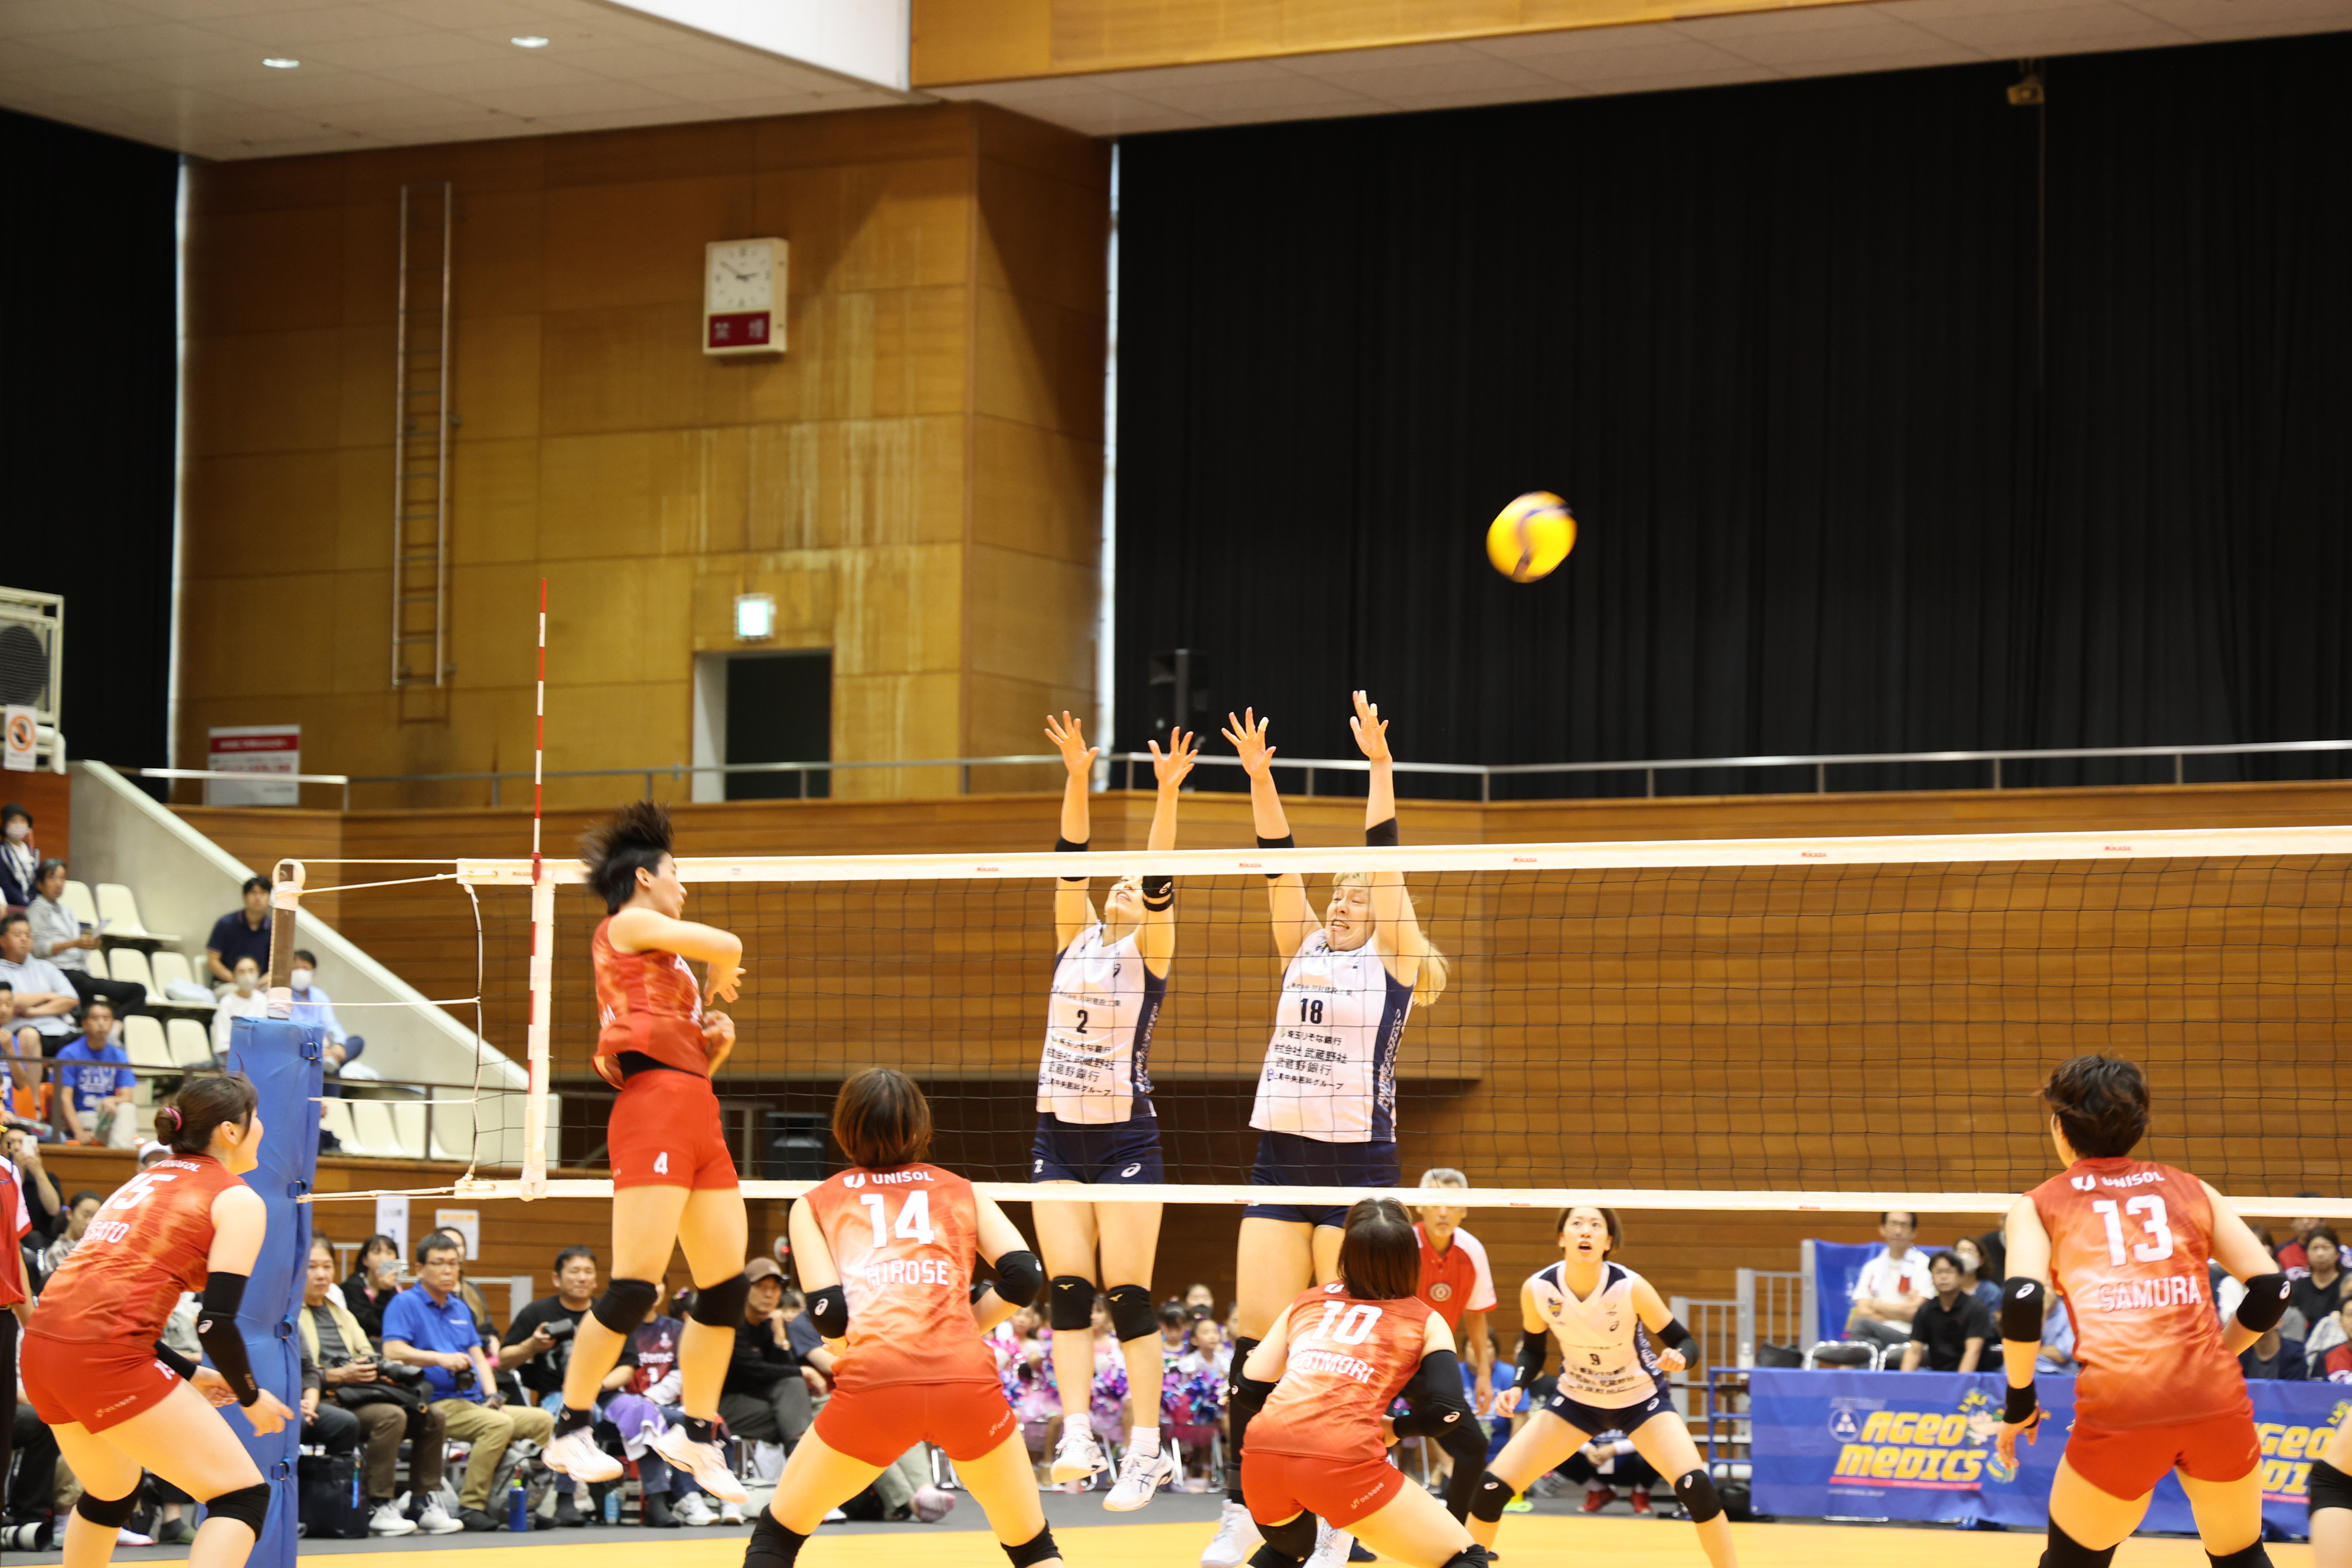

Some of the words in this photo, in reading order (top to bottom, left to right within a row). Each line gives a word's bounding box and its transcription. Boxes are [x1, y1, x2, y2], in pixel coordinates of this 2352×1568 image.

[1076, 1010, 1089, 1034] 2
[1301, 998, 1323, 1024] 18
[653, 1151, 668, 1175] 4
[871, 1171, 935, 1184] UNISOL
[98, 1172, 178, 1210] 15
[2101, 1171, 2165, 1188] UNISOL
[860, 1190, 935, 1249] 14
[2092, 1194, 2174, 1268] 13
[865, 1259, 949, 1291] HIROSE
[2099, 1275, 2203, 1312] SAMURA
[1310, 1299, 1383, 1346] 10
[1589, 1353, 1602, 1366] 9
